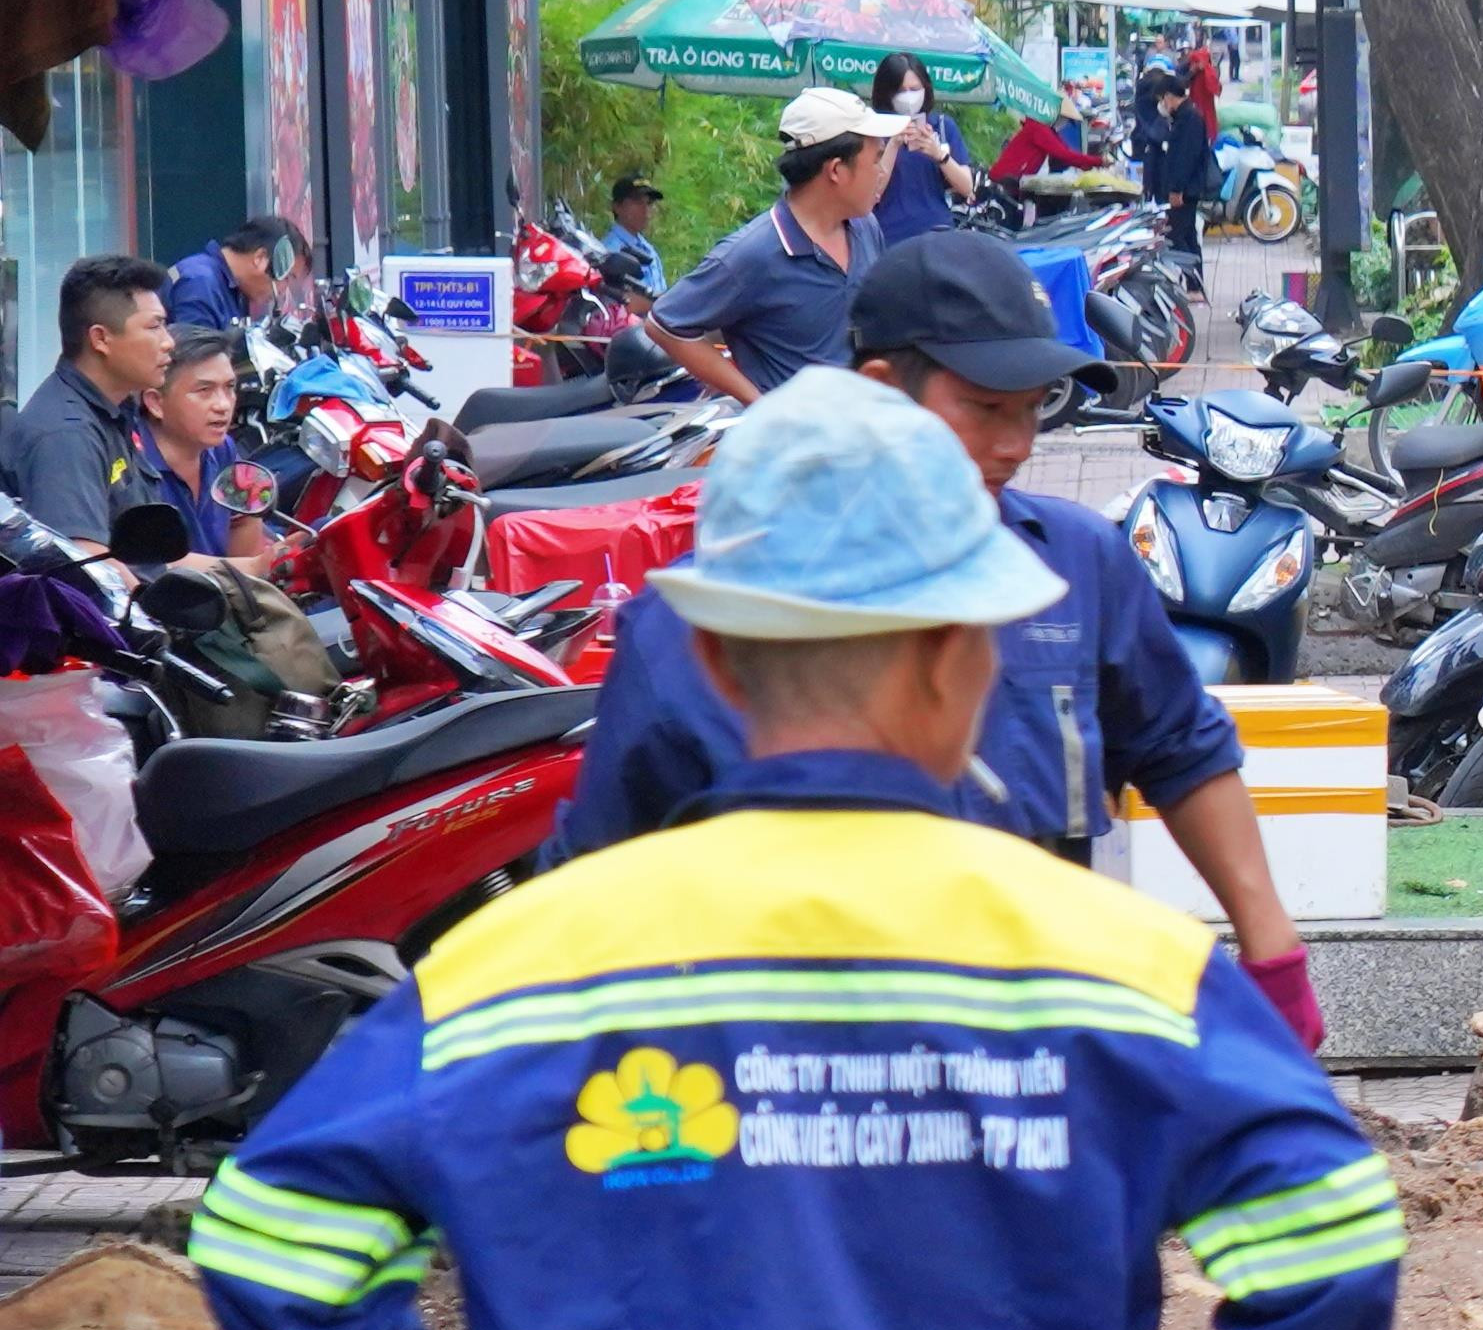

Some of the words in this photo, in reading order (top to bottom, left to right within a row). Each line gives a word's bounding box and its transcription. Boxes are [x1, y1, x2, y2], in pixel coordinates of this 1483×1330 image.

[646, 45, 680, 67] TRÀ
[683, 46, 698, 66] Ô
[701, 49, 744, 68] LONG
[838, 57, 877, 74] LONG
[387, 777, 537, 844] FUTURE
[735, 1043, 797, 1093] CÔNG
[795, 1053, 828, 1093] TY
[739, 1099, 801, 1166] CÔNG
[799, 1101, 855, 1167] VIÊN
[855, 1101, 906, 1166] CÂY
